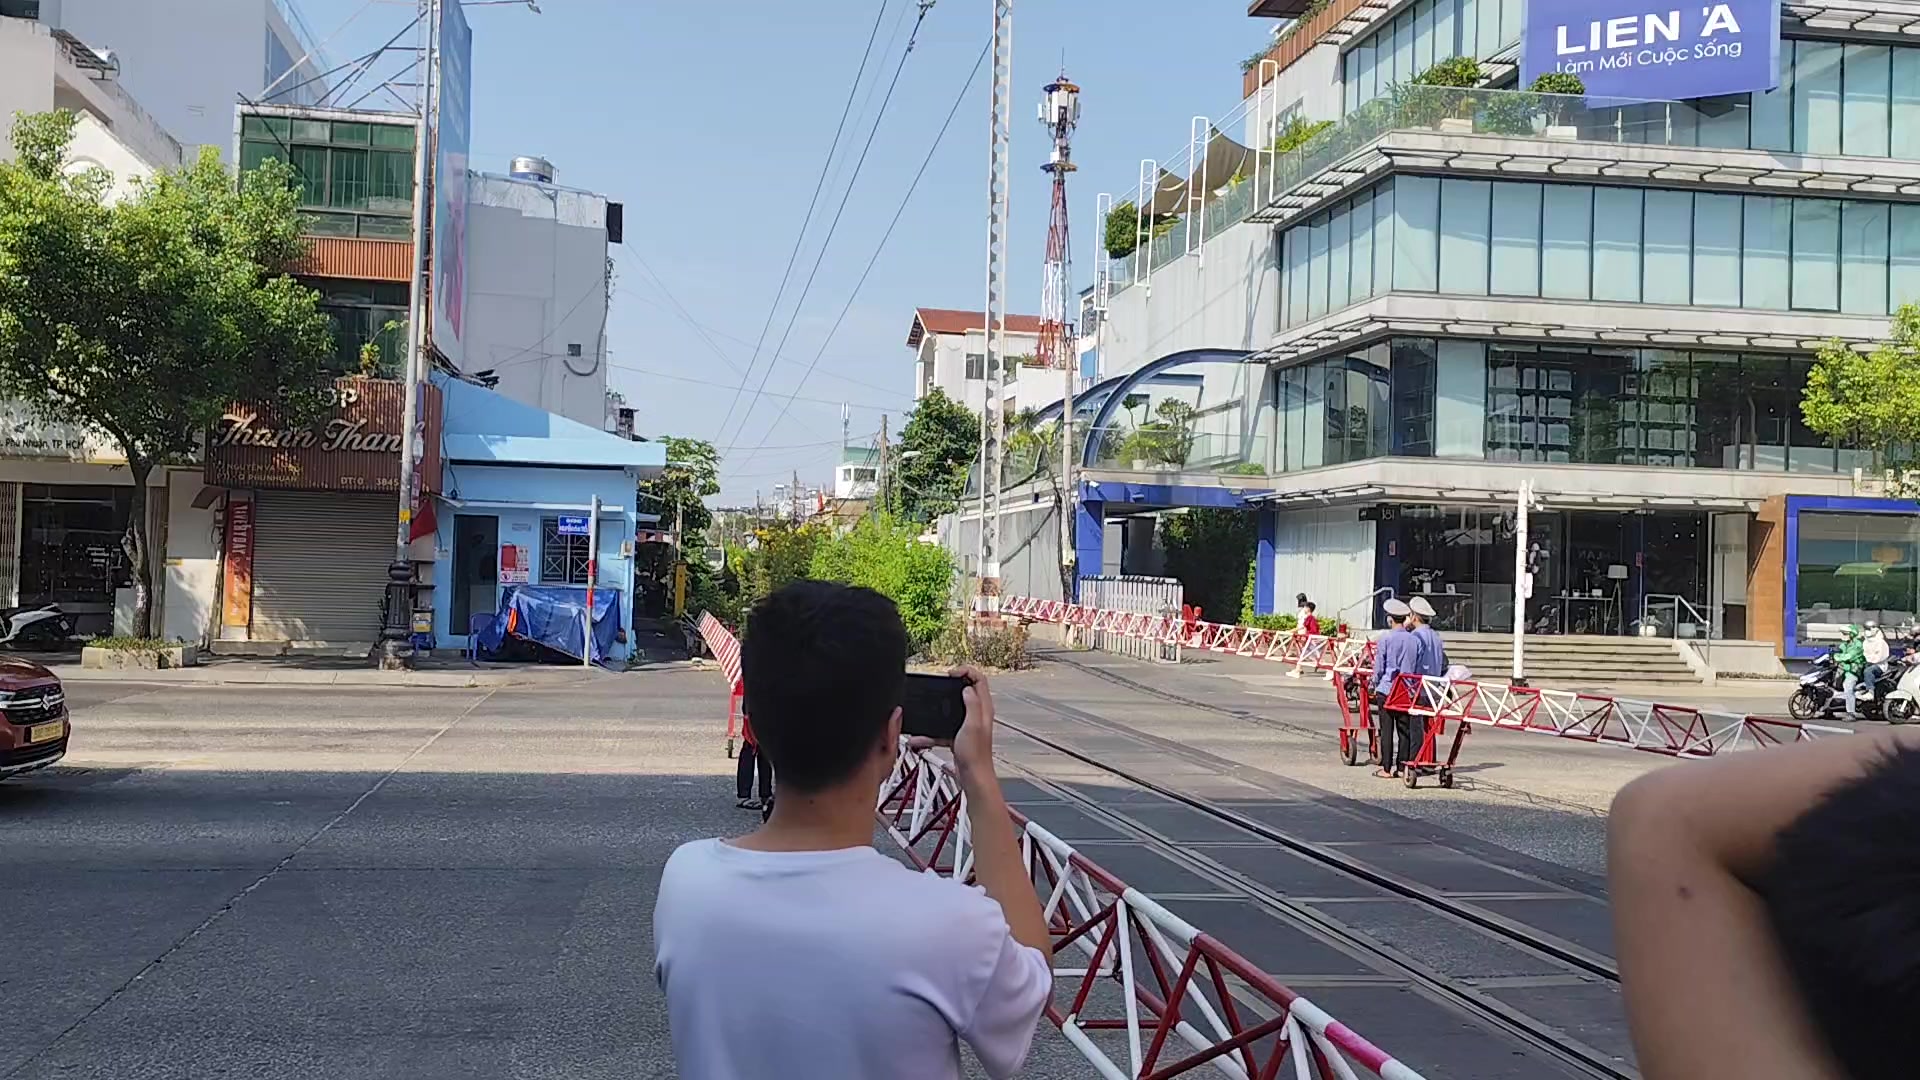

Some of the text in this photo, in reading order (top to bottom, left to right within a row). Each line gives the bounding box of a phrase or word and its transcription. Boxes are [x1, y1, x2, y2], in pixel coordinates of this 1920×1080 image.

[1556, 10, 1680, 56] LIEN
[1556, 38, 1742, 74] Làm Mới Cuộc Sống
[52, 439, 63, 449] TP.
[321, 417, 424, 452] Than
